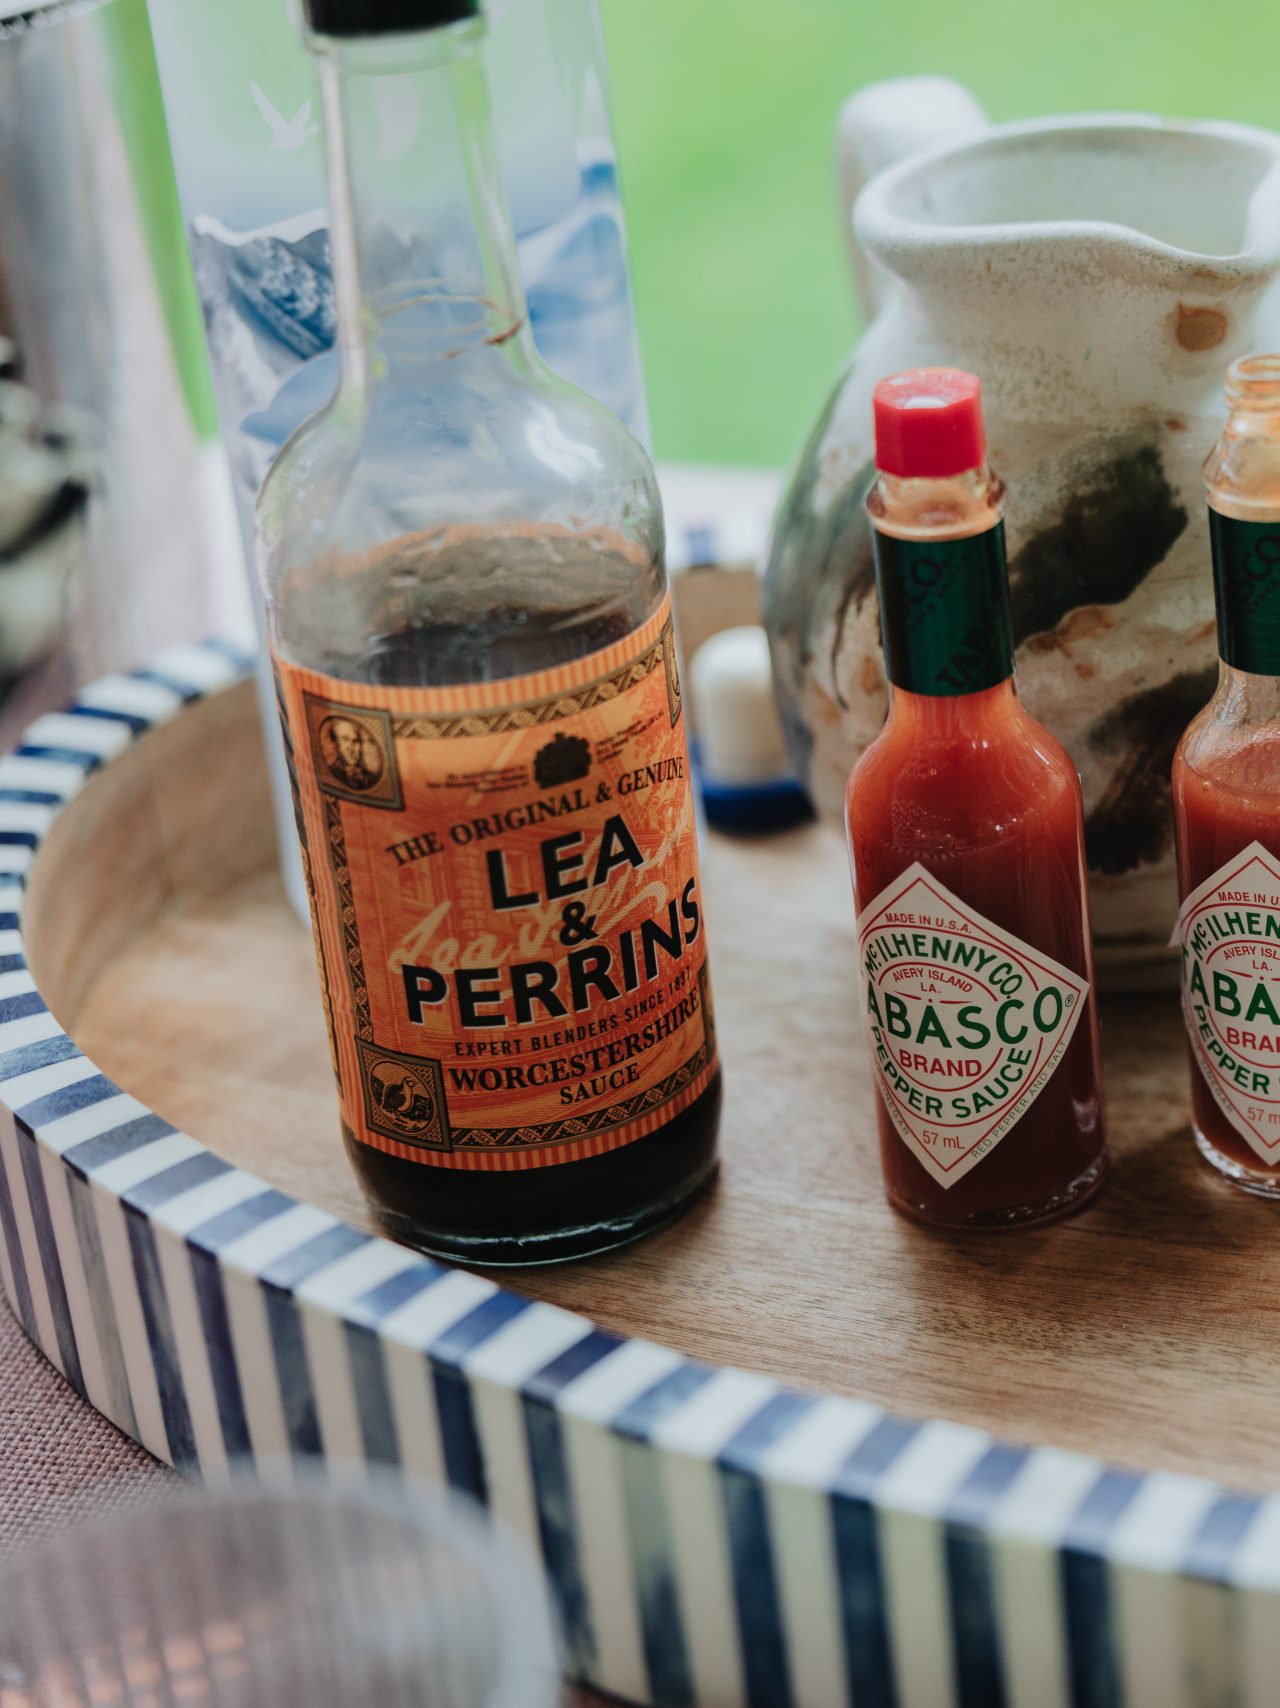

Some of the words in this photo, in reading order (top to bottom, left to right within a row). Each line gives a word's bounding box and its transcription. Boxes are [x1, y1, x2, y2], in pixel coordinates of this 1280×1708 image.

[386, 830, 444, 866] THE
[449, 789, 590, 846] ORIGINAL
[596, 783, 612, 803] &
[617, 756, 683, 797] GENUINE
[486, 815, 644, 910] LEA
[1217, 891, 1250, 904] MADE
[1253, 893, 1266, 904] IN
[559, 901, 598, 946] &
[885, 912, 917, 925] MADE
[918, 915, 931, 926] IN
[936, 916, 973, 934] U.S.A.
[401, 877, 700, 1027] PERRINS
[1223, 945, 1256, 960] AVERY
[1252, 959, 1273, 972] LA.
[892, 968, 924, 983] AVERY
[928, 969, 973, 993] ISLAND
[920, 982, 941, 994] LA.
[454, 1039, 522, 1057] EXPERT
[531, 1014, 618, 1051] BLENDERS
[624, 989, 663, 1023] SINCE
[668, 965, 691, 996] 1837
[866, 979, 1063, 1049] ABASCO
[448, 986, 699, 1091] WORCESTERSHIRE
[1193, 1005, 1270, 1095] PEPPER
[560, 1062, 640, 1105] SAUCE
[871, 1026, 943, 1119] PEPPER
[951, 1047, 1032, 1119] SAUCE
[899, 1048, 982, 1078] BRAND
[971, 1139, 993, 1159] RED
[992, 1098, 1028, 1137] PEPPER
[1029, 1072, 1048, 1096] AND
[1047, 1041, 1066, 1069] SALT
[1247, 1106, 1264, 1121] 57
[922, 1130, 939, 1146] 57
[943, 1136, 966, 1150] mL
